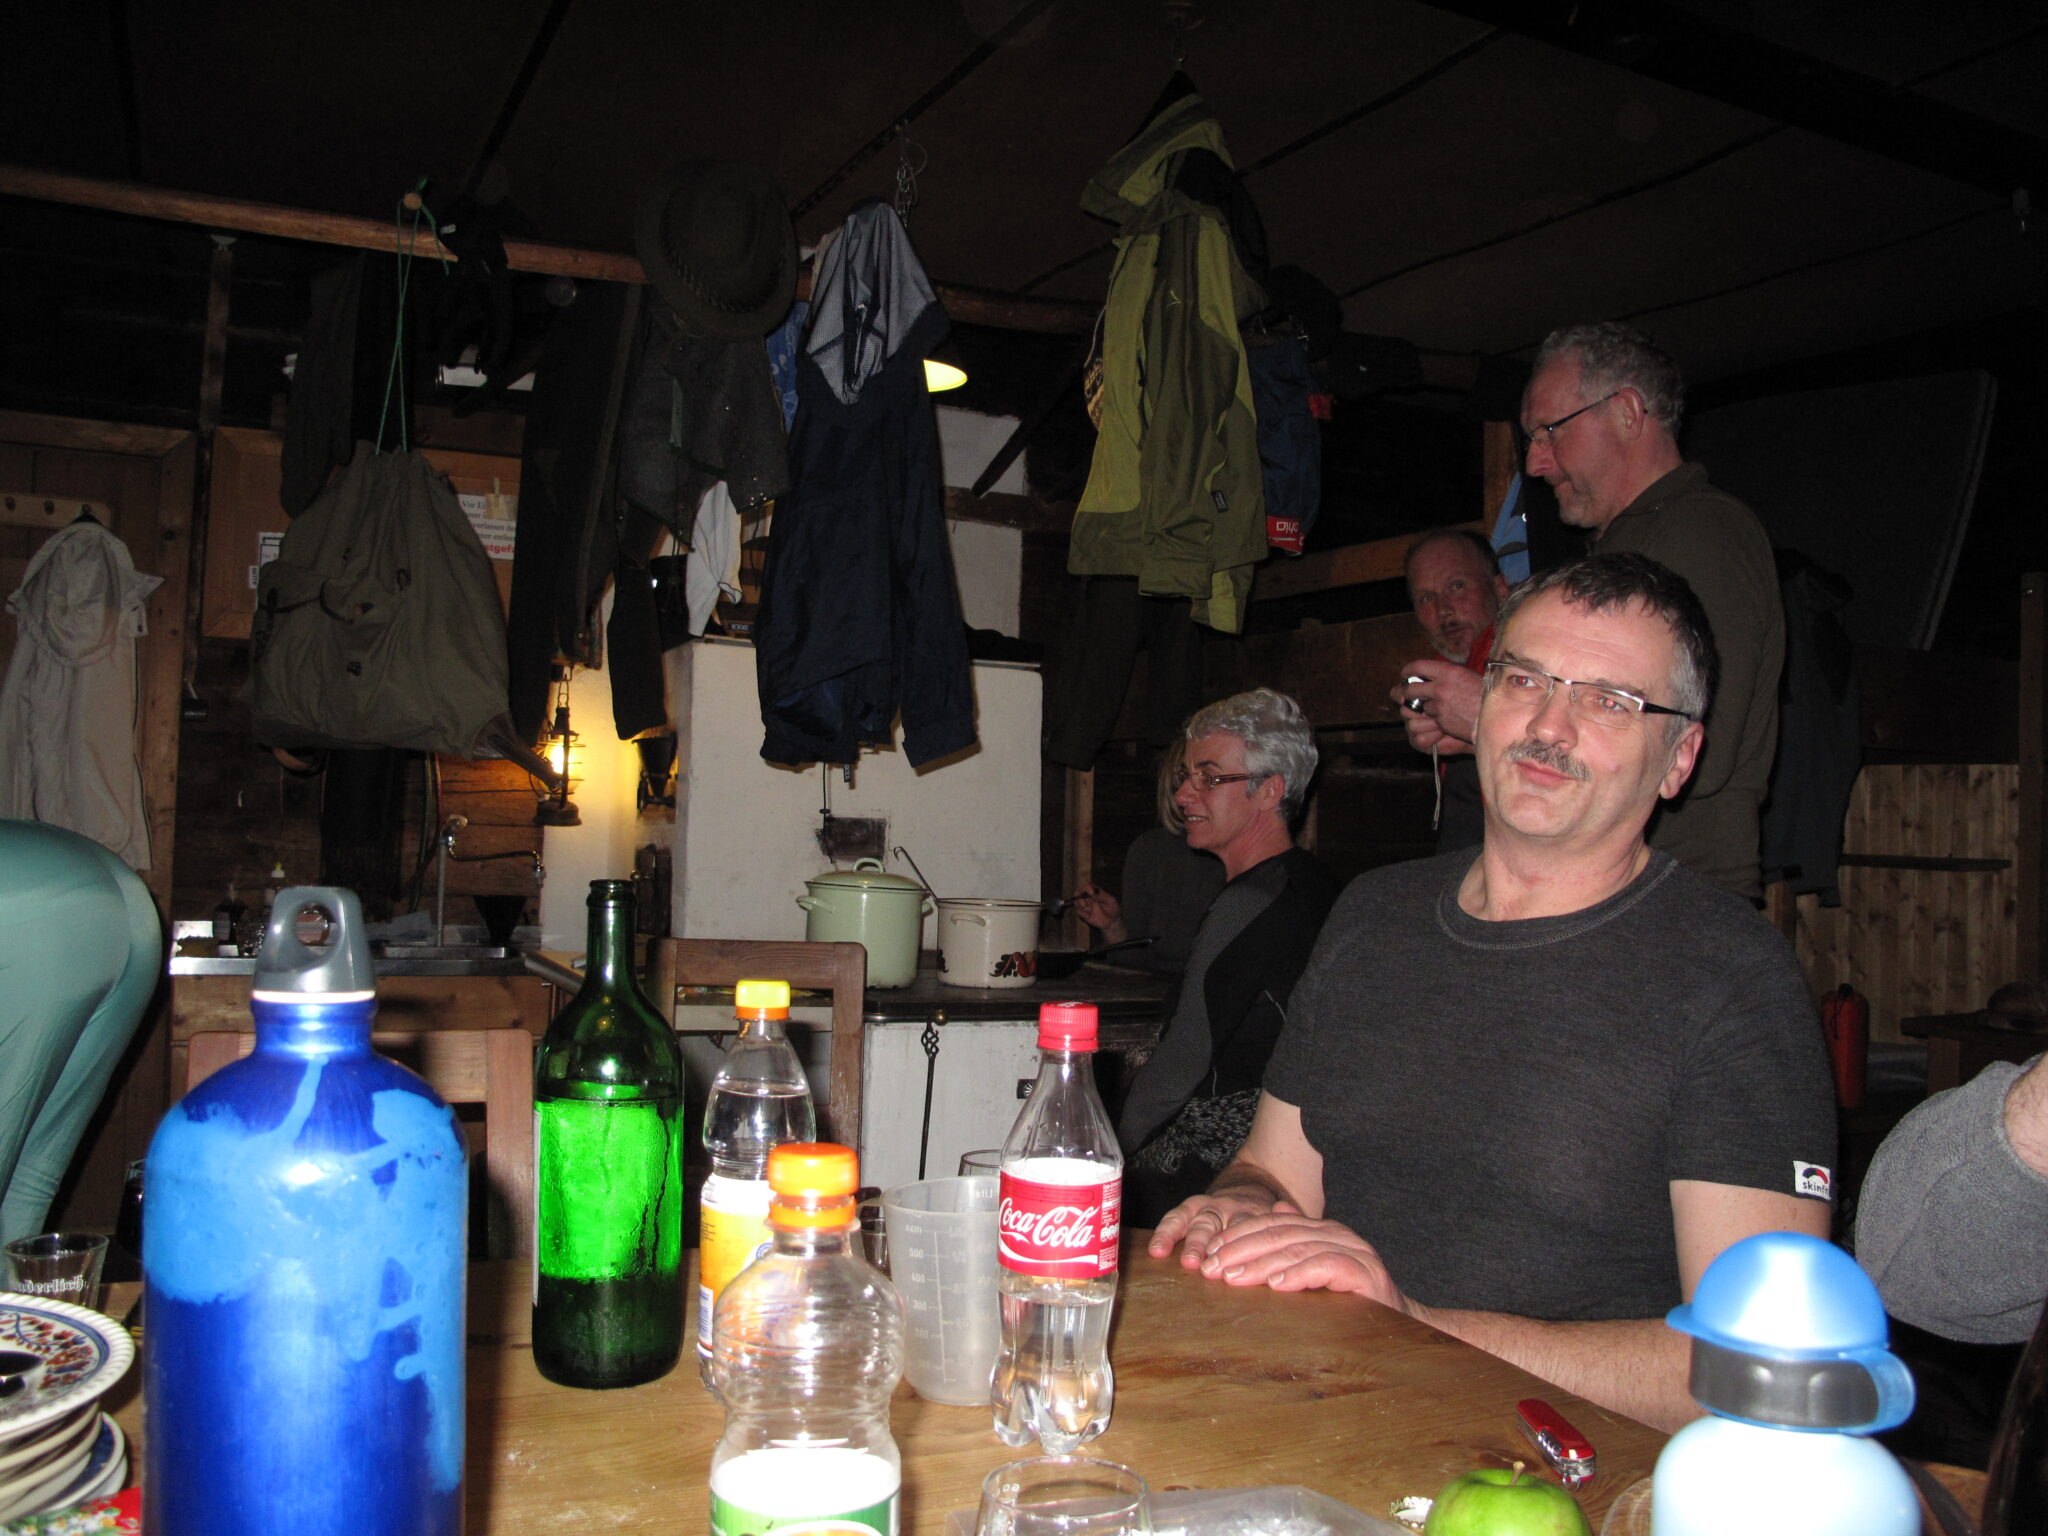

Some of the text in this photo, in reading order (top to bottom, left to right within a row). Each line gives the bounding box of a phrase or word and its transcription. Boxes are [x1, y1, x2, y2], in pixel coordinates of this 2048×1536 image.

[999, 1197, 1100, 1249] Coca-Cola
[908, 1247, 924, 1259] 500
[911, 1271, 926, 1284] 400
[912, 1298, 928, 1311] 300
